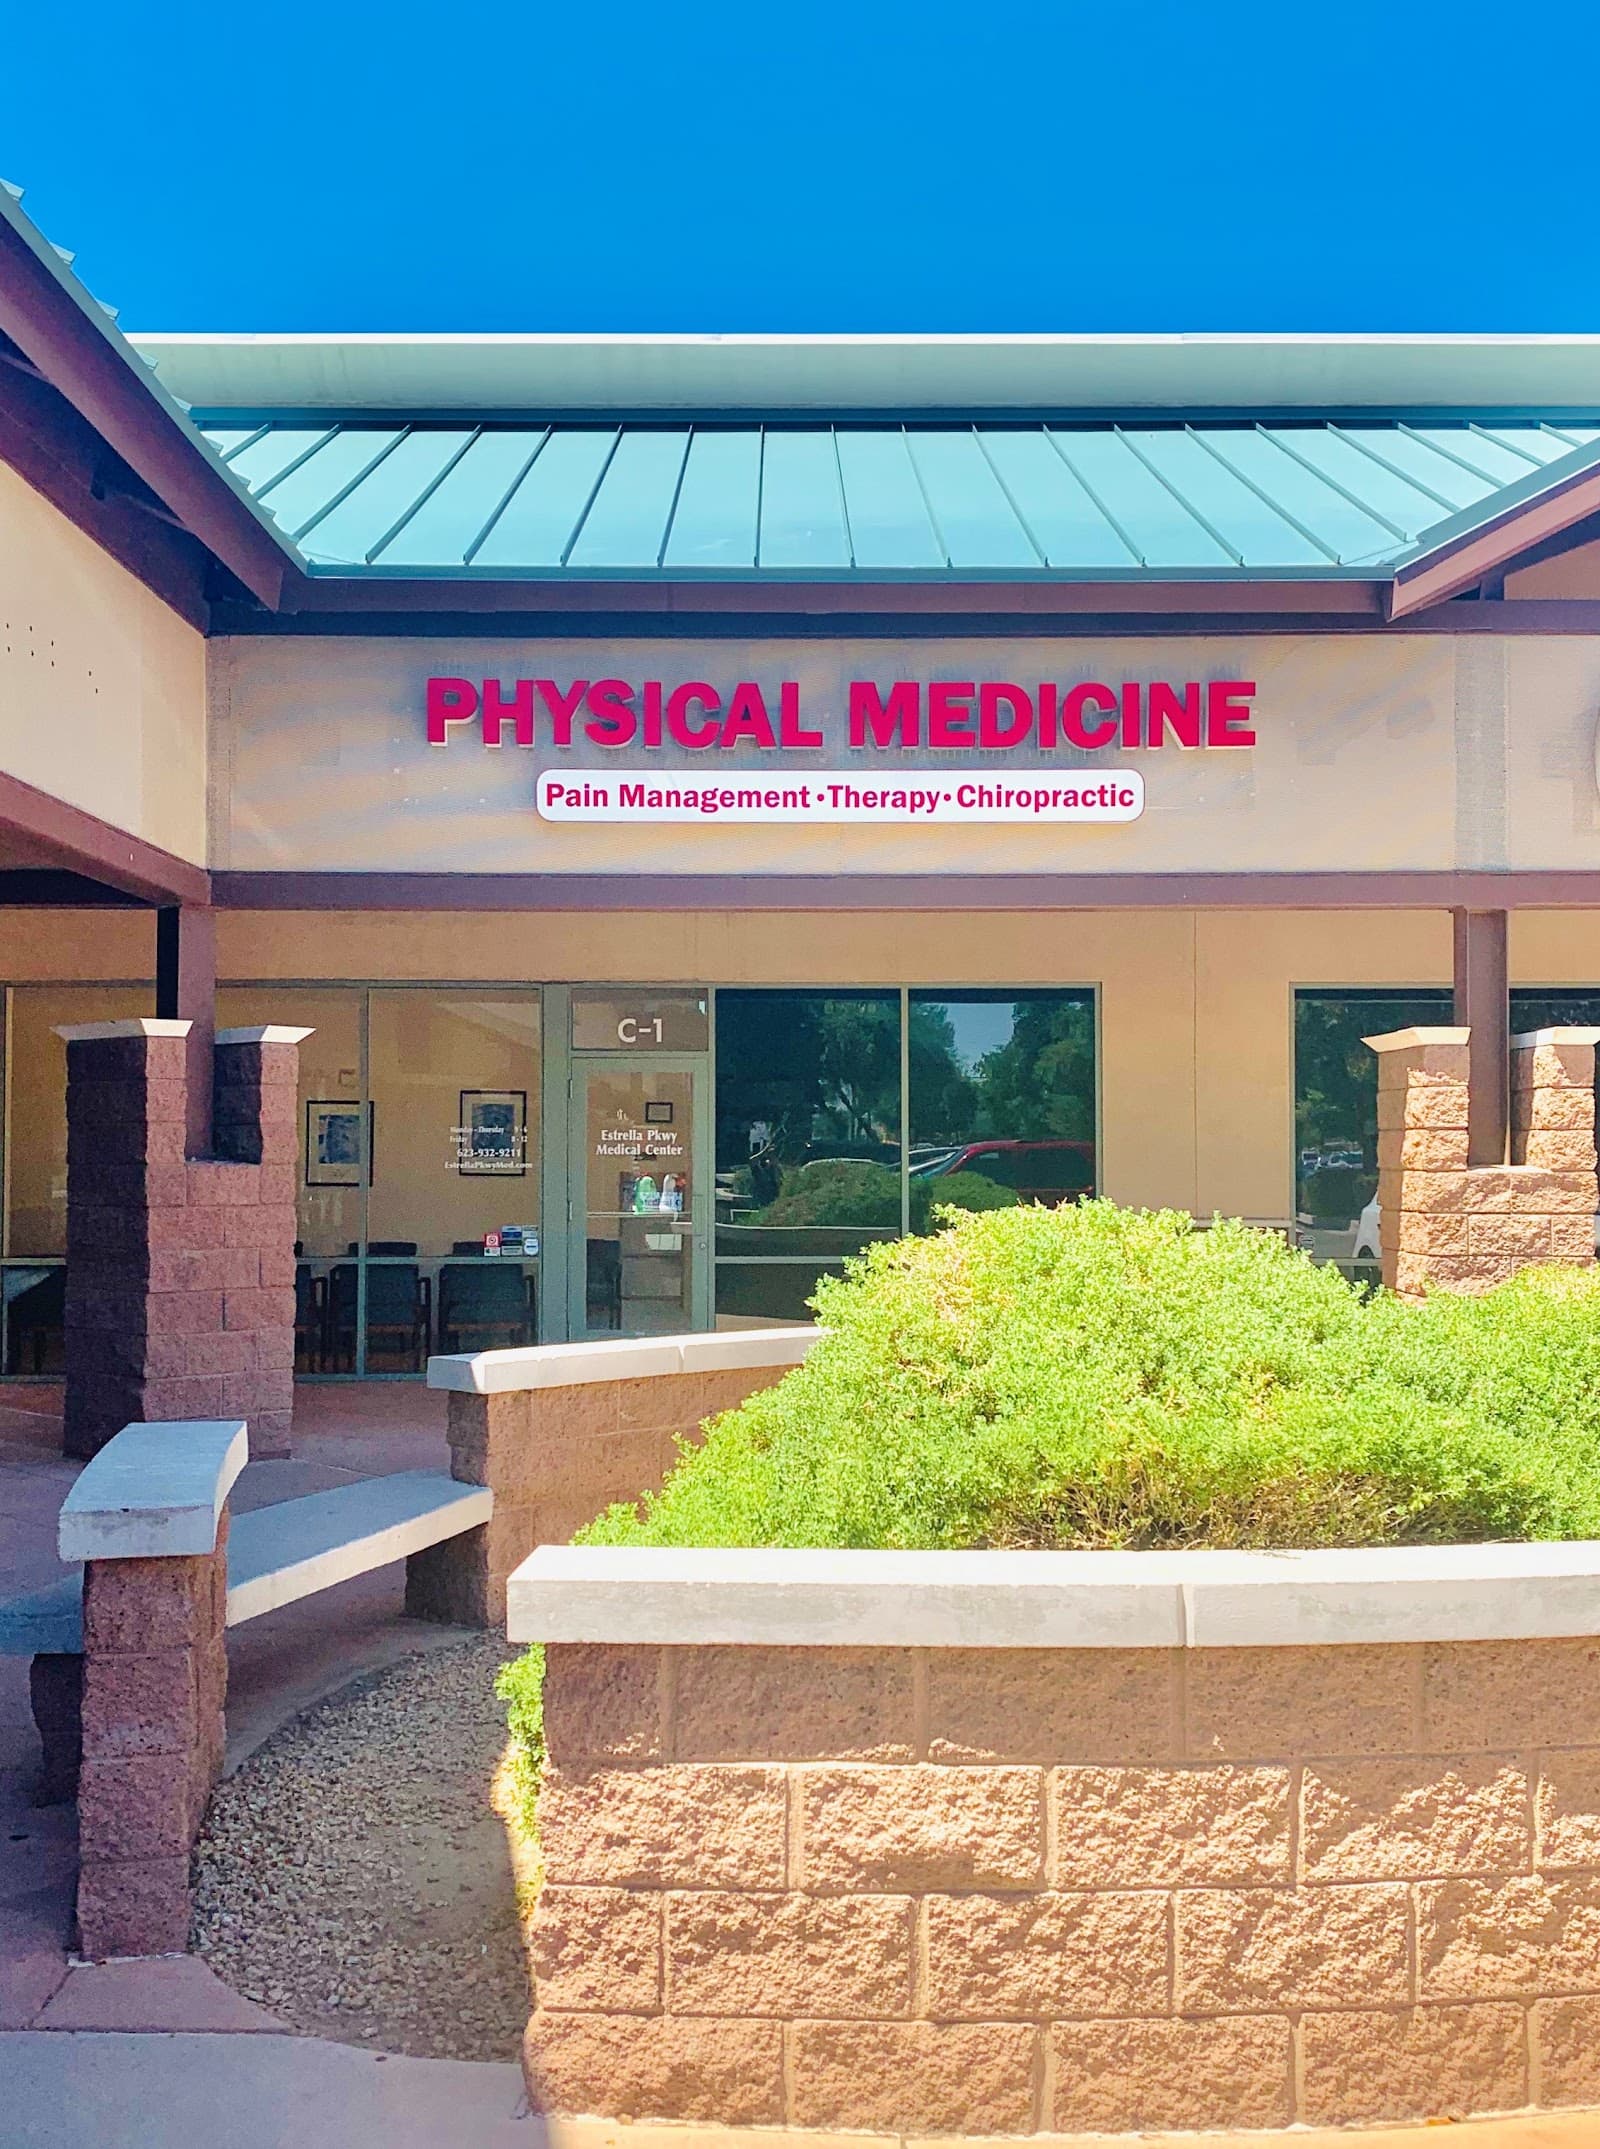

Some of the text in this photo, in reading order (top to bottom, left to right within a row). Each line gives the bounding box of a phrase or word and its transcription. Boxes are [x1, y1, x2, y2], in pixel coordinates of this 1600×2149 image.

[427, 678, 1257, 750] PHYSICAL MEDICINE
[546, 783, 608, 808] Pain
[956, 784, 1135, 813] Chiropractic
[617, 1017, 664, 1044] C-1
[600, 1129, 678, 1145] Estrella Pkwy
[456, 1147, 521, 1158] 623-932-9211
[595, 1144, 684, 1156] Medical Center
